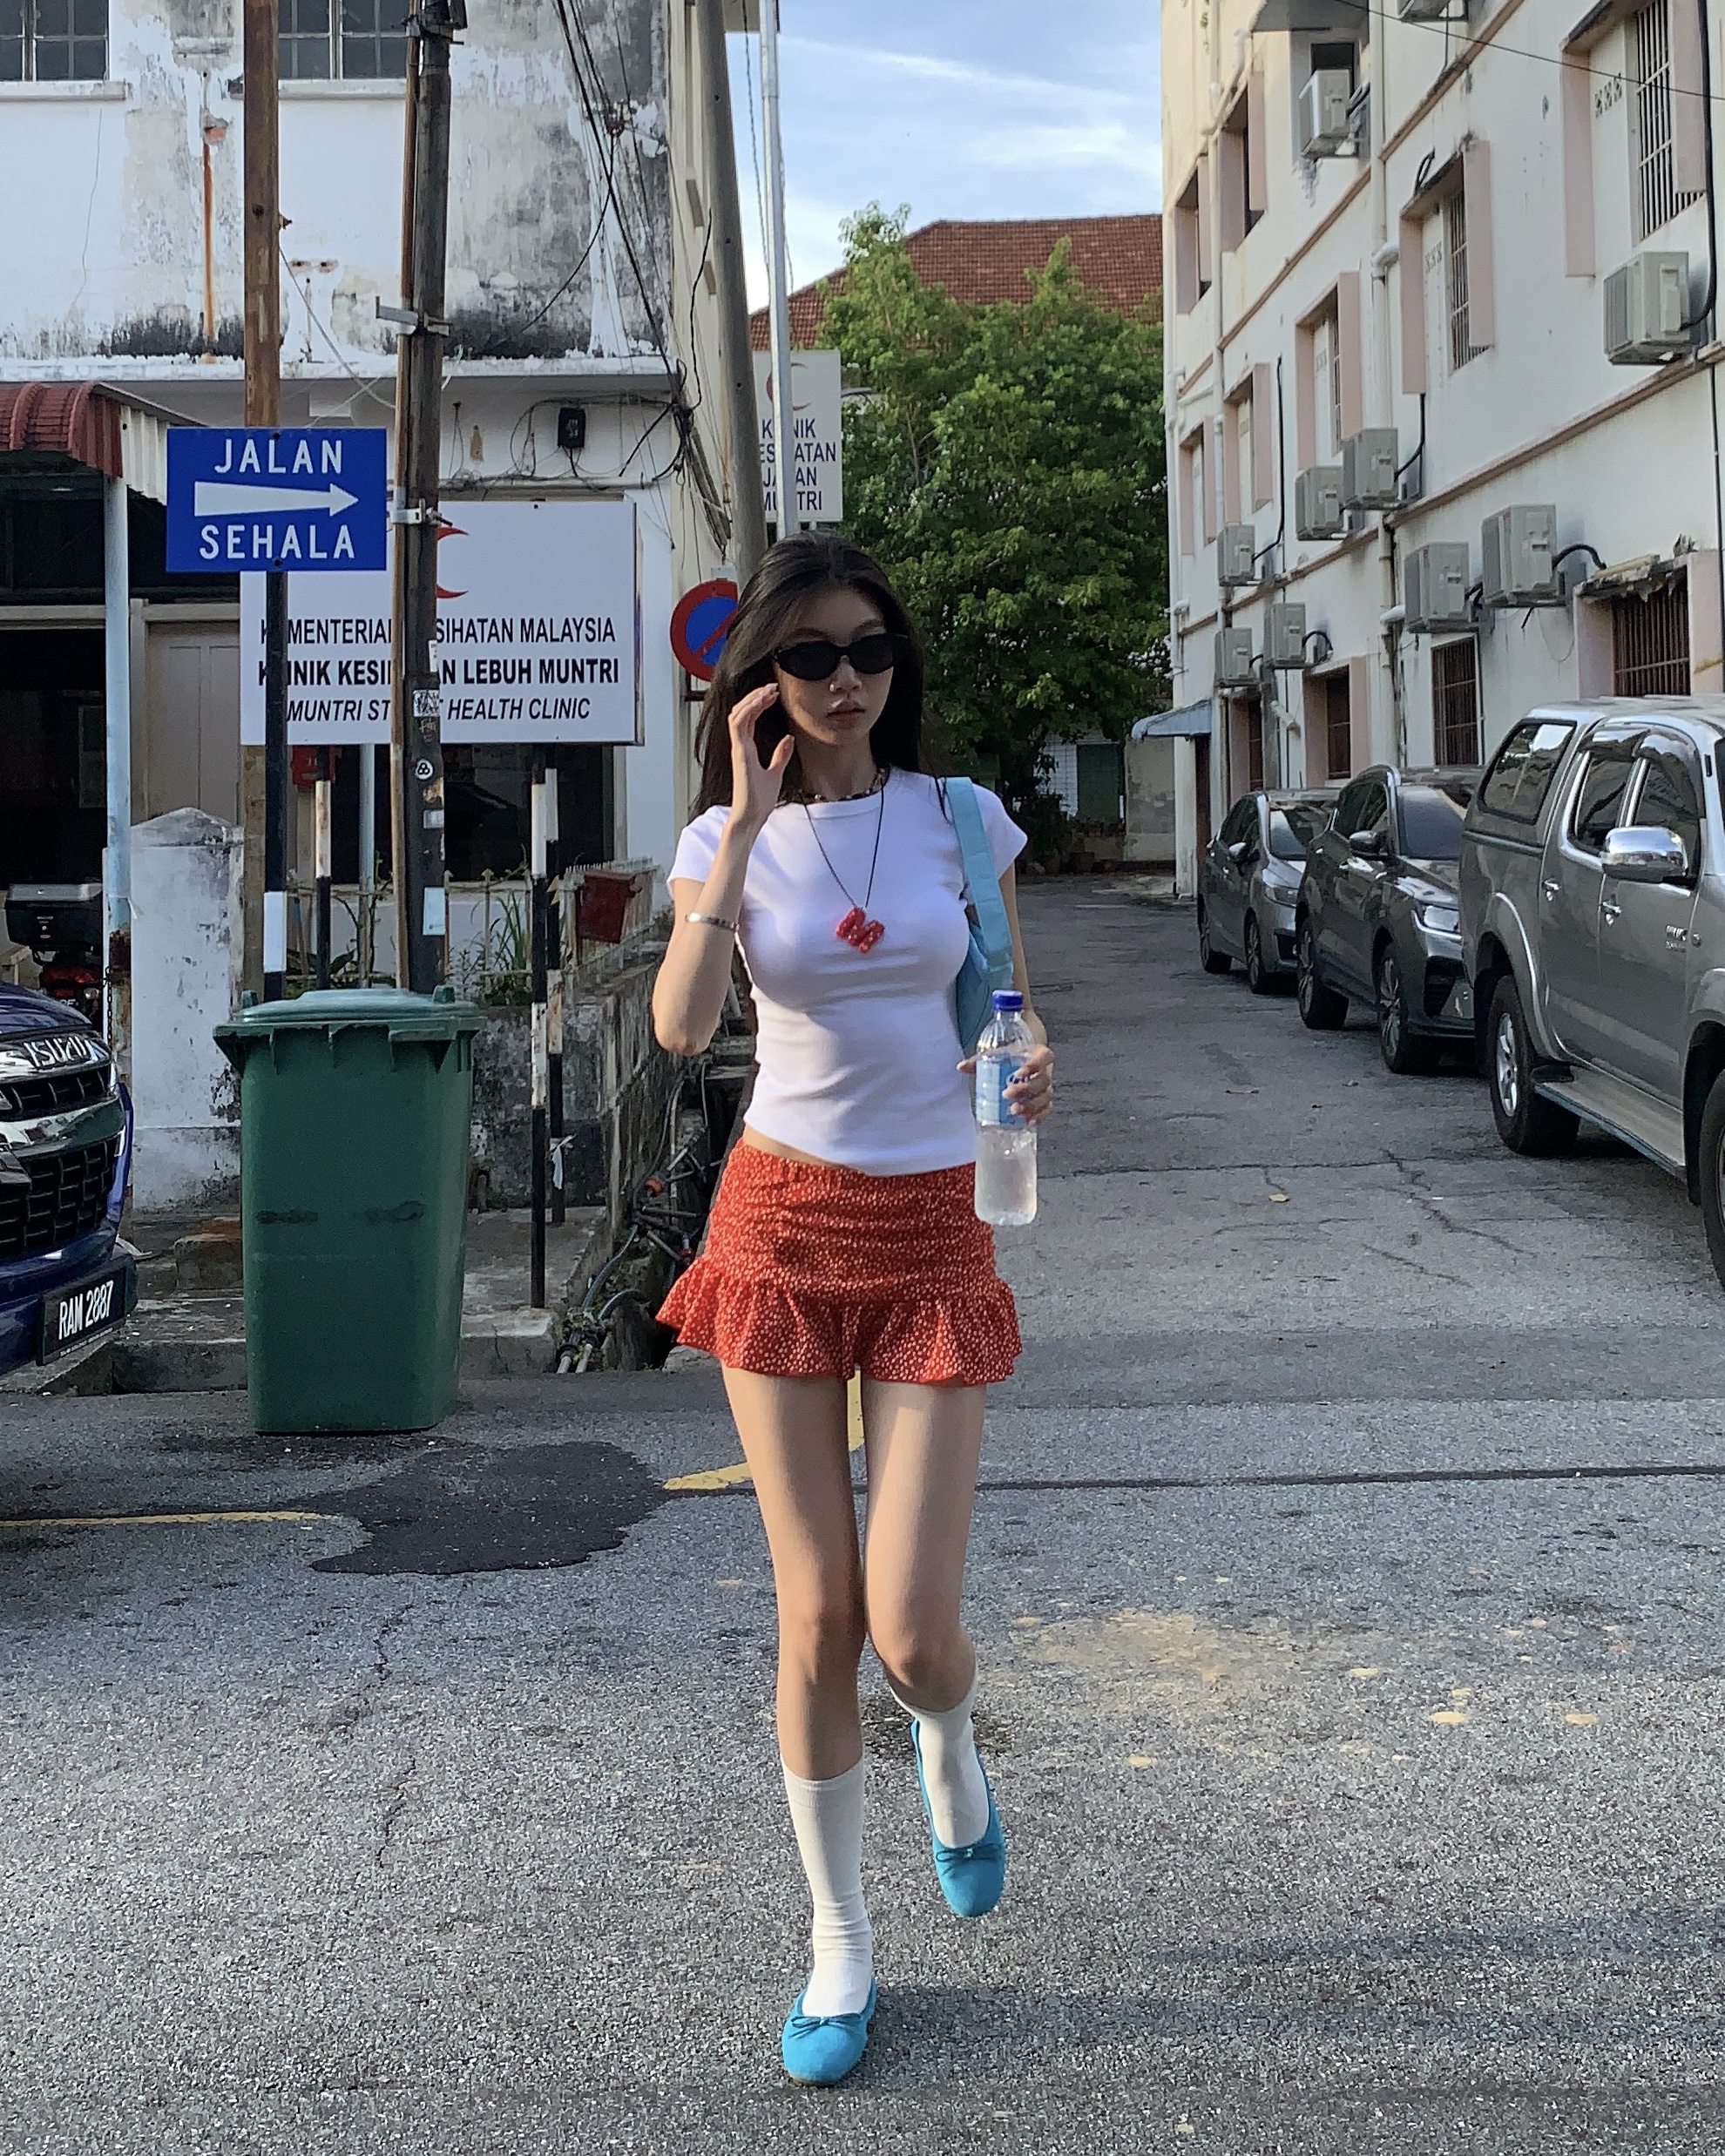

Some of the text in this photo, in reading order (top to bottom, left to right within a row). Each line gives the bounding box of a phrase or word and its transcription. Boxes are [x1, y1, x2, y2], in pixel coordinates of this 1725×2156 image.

[214, 438, 342, 474] JALAN
[199, 524, 355, 560] SEHALA
[520, 616, 616, 643] MALAYSIA
[463, 658, 531, 685] LEBUH
[538, 657, 619, 684] MUNTRI
[287, 699, 362, 722] MUNTRI
[447, 697, 524, 720] HEALTH
[528, 696, 591, 720] CLINIC
[23, 1035, 88, 1068] ISUZU
[58, 1279, 115, 1341] RAM 2887
